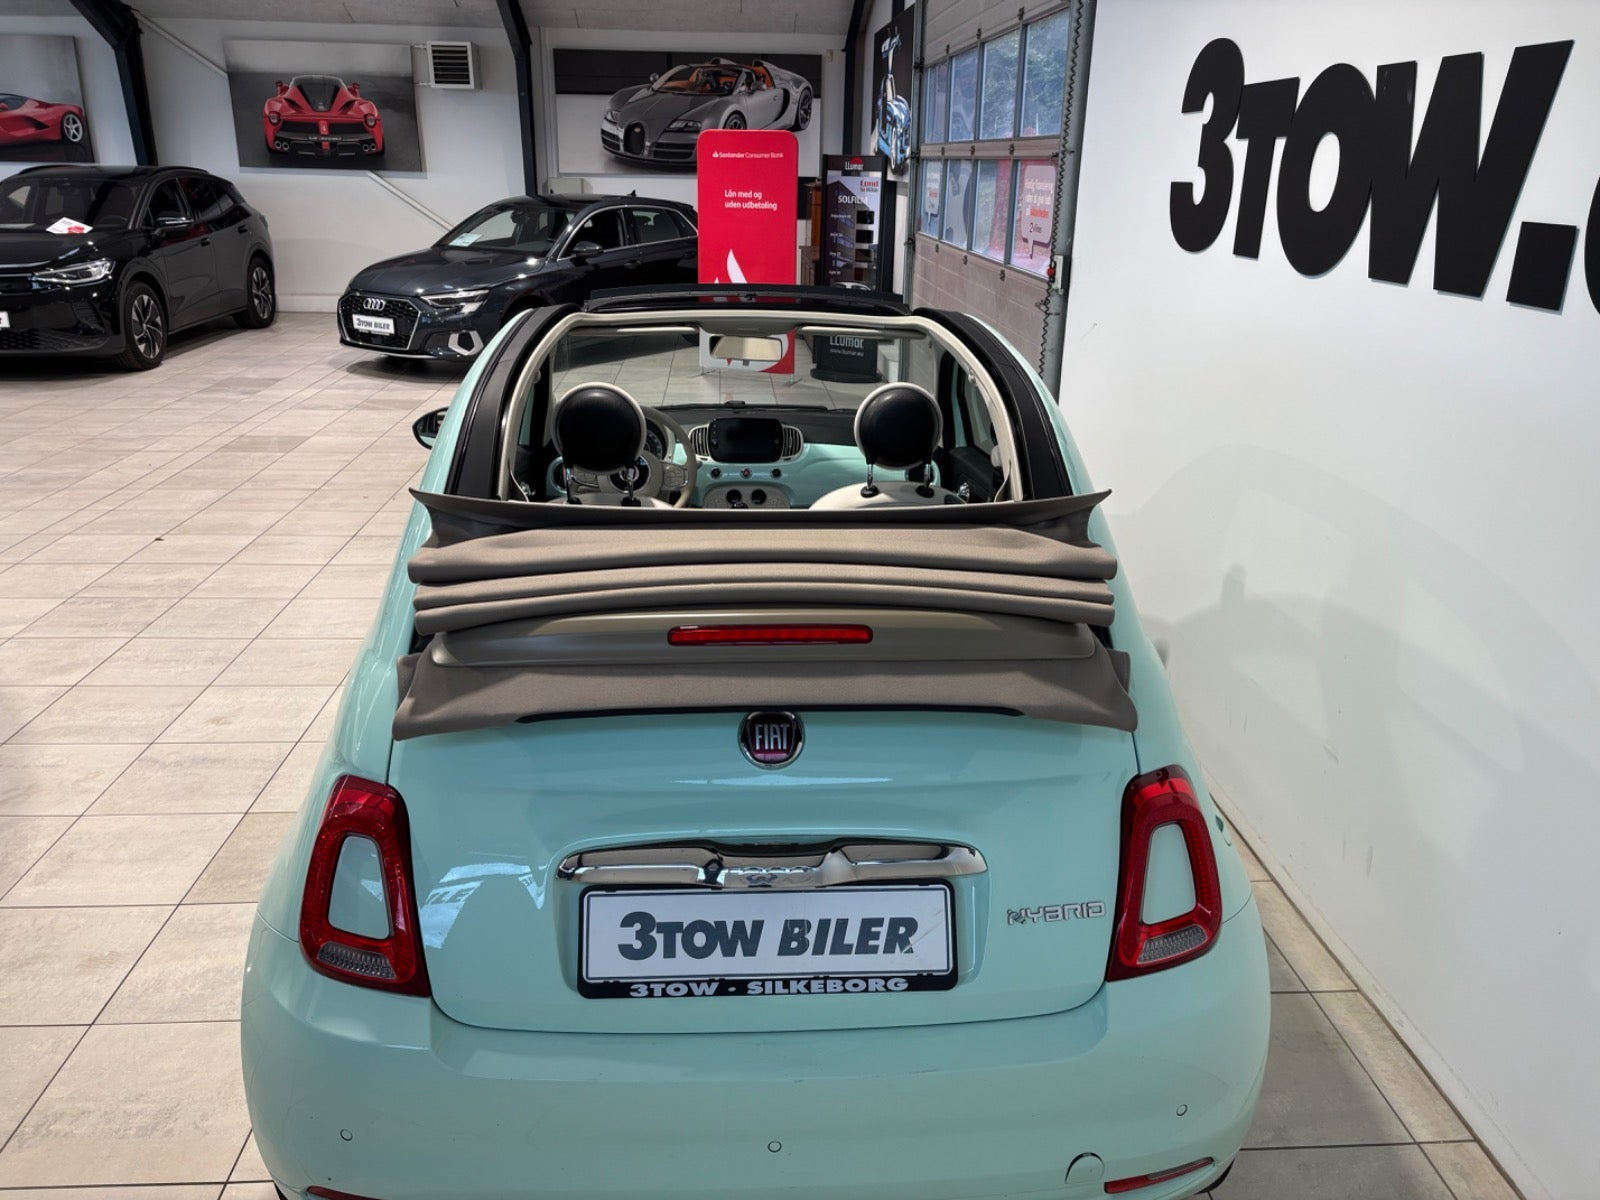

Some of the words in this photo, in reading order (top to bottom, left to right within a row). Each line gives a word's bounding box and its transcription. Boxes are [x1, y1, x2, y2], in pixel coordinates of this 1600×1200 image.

[719, 151, 745, 159] Santander
[1170, 38, 1600, 313] 3TOW.
[724, 189, 737, 198] Lån
[738, 190, 753, 198] med
[754, 191, 763, 201] og
[724, 200, 741, 209] uden
[742, 200, 778, 212] udbetaling
[754, 723, 791, 750] FIAT
[1006, 901, 1106, 925] HYBRID
[617, 911, 765, 961] 3TOW
[776, 916, 919, 957] BILER
[629, 981, 720, 998] 3TOW
[746, 977, 909, 995] SILKEBORG
